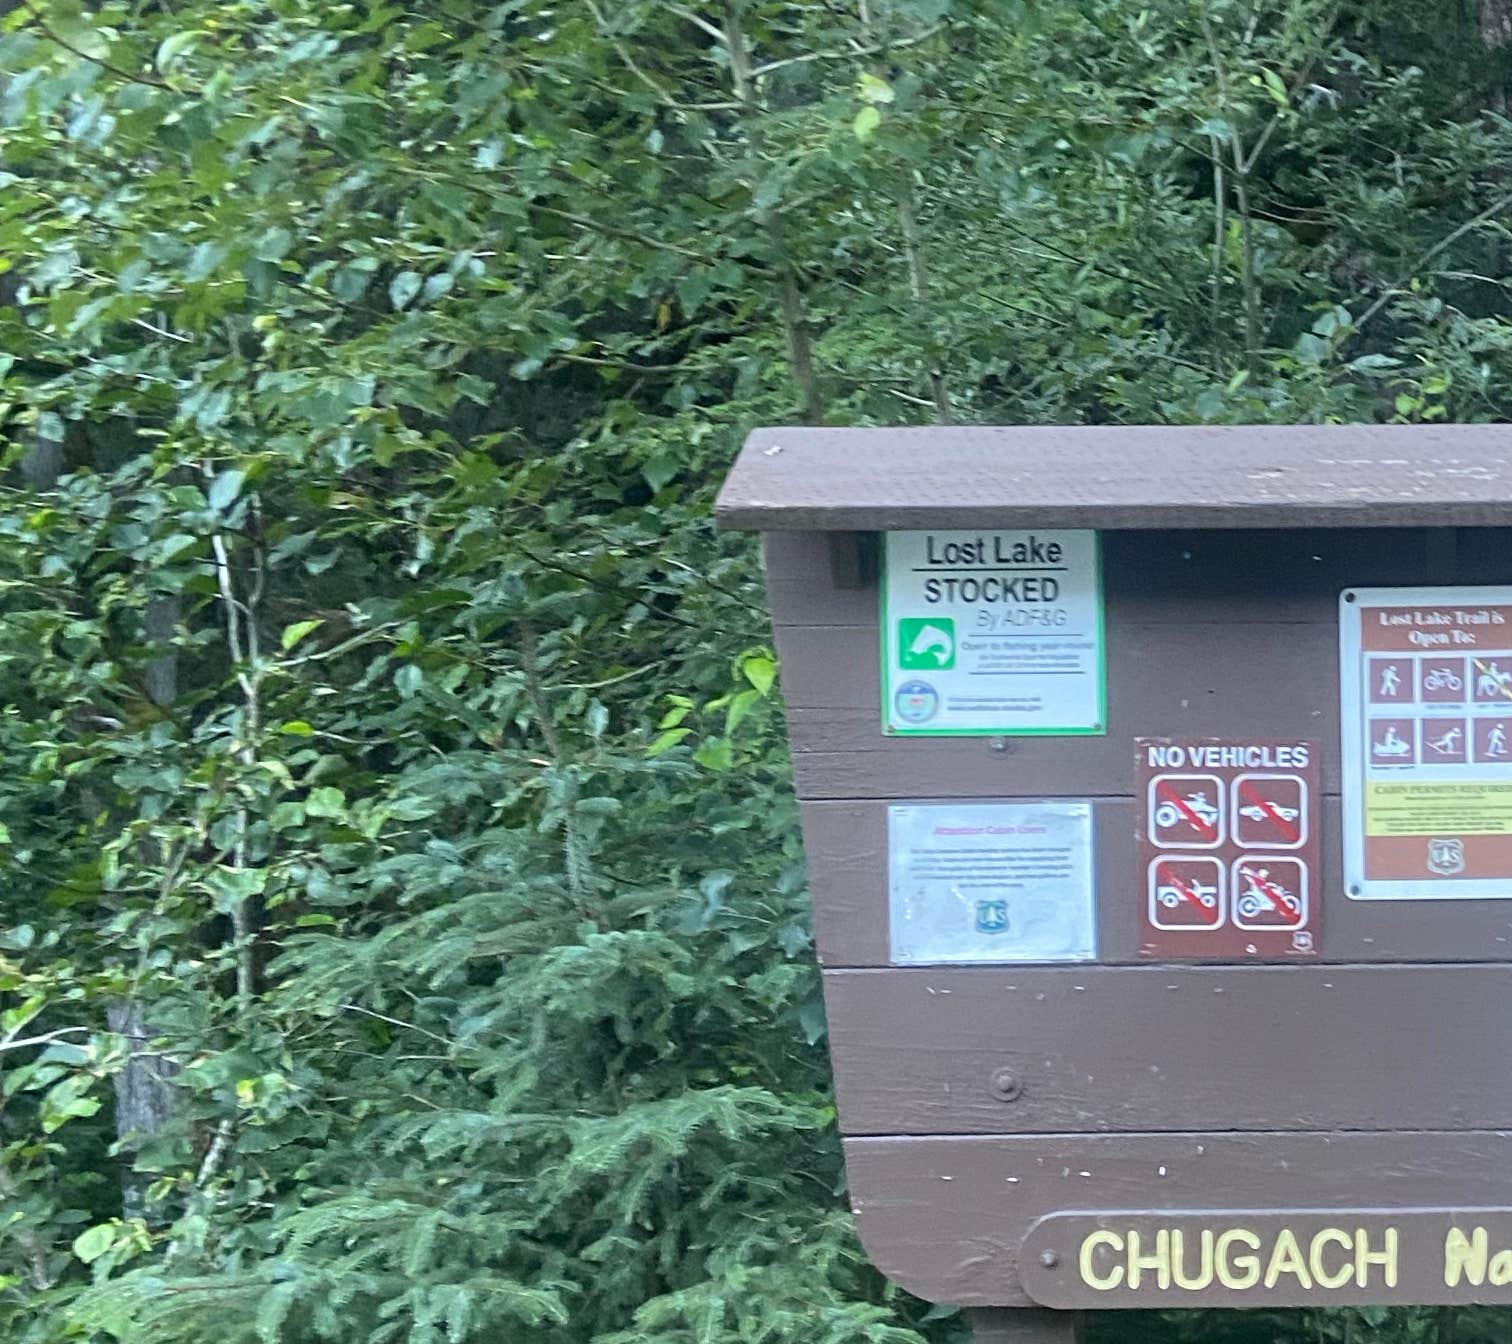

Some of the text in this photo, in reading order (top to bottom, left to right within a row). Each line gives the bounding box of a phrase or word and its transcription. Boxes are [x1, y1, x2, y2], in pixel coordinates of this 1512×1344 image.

[927, 535, 1062, 565] Lost Lake
[924, 577, 1059, 603] STOCKED
[976, 608, 1068, 632] By ADF&G
[1379, 612, 1412, 626] Lost
[1414, 611, 1451, 626] Lake
[1453, 610, 1490, 625] Trail
[1408, 630, 1449, 647] Open
[1148, 746, 1309, 768] NO VEHICLES
[1079, 1227, 1398, 1290] CHUGACH
